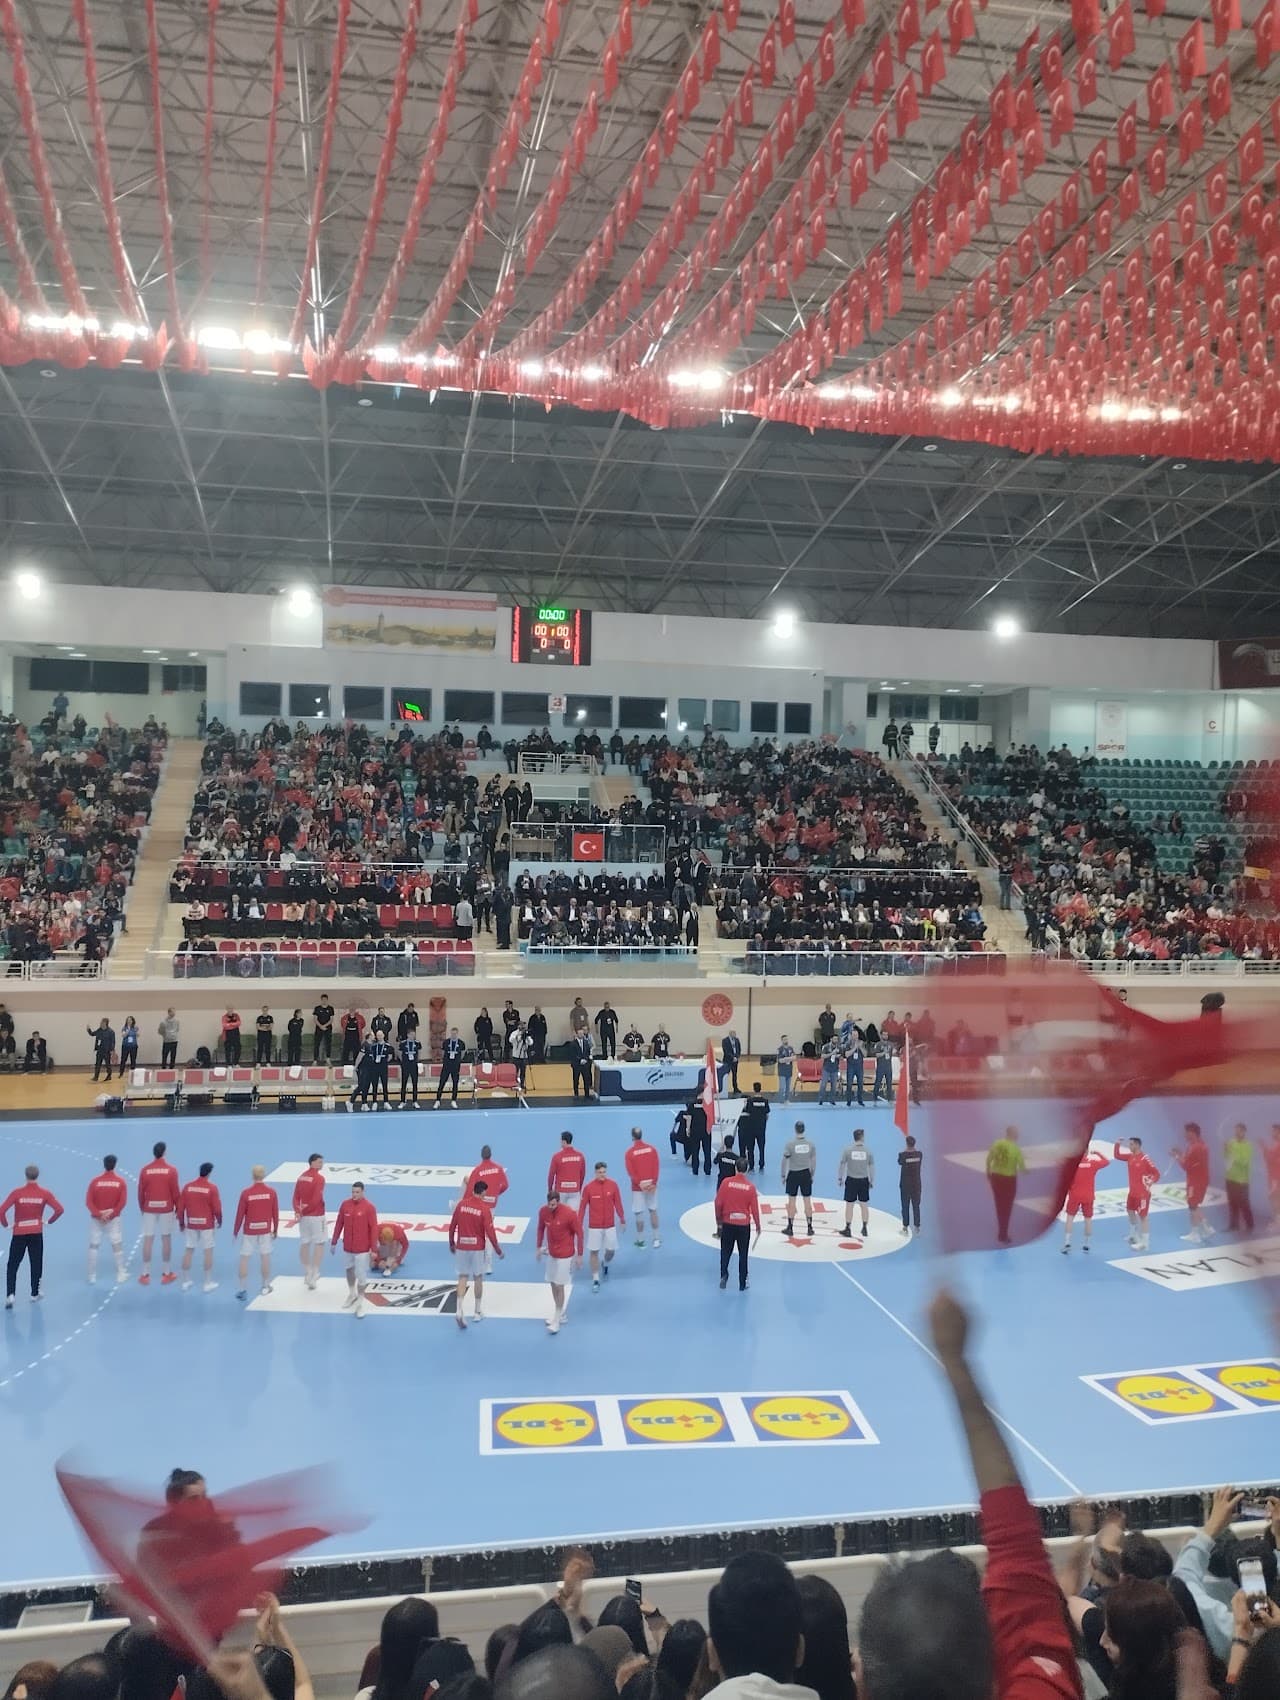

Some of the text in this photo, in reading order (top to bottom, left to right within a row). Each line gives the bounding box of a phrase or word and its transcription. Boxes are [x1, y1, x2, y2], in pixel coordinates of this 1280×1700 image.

[539, 609, 565, 620] 00:00
[534, 625, 547, 635] 00
[556, 626, 569, 636] 00
[1208, 720, 1217, 729] C
[1128, 1387, 1201, 1401] LIDL
[503, 1411, 841, 1432] LIDL LIDL LIDL
